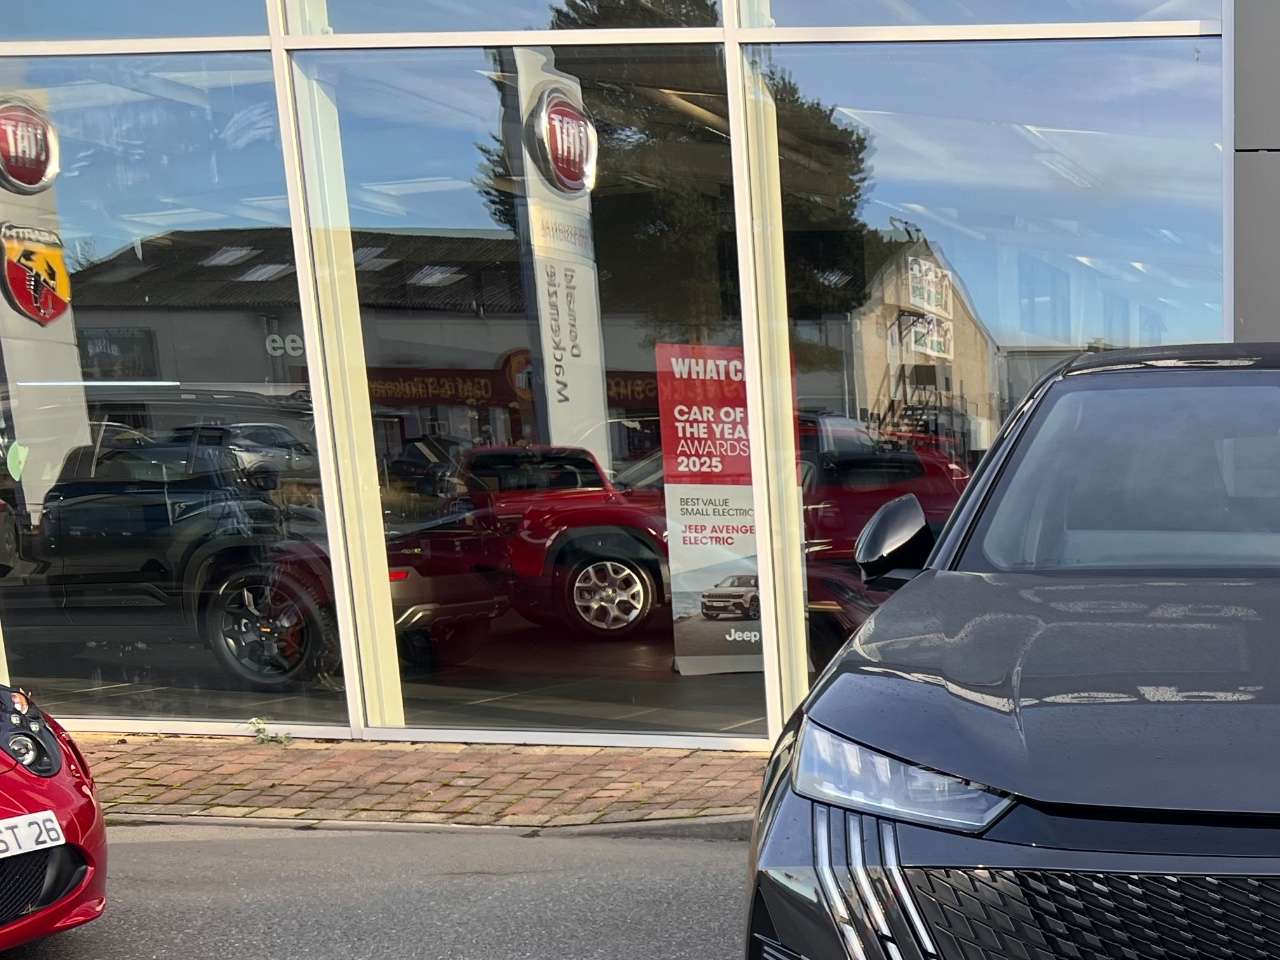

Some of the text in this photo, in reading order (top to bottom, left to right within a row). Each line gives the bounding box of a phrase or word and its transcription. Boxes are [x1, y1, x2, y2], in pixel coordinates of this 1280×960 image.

[671, 357, 746, 383] WHATC
[674, 404, 744, 423] CAR OF
[675, 422, 750, 440] THE YEA
[676, 440, 749, 456] AWARDS
[677, 456, 722, 472] 2025
[680, 498, 730, 507] BEST VALUE
[680, 508, 754, 517] SMALL ELECTRIC
[682, 525, 707, 534] JEEP
[682, 536, 735, 546] ELECTRIC
[725, 628, 760, 643] Jeep
[28, 818, 61, 846] 26
